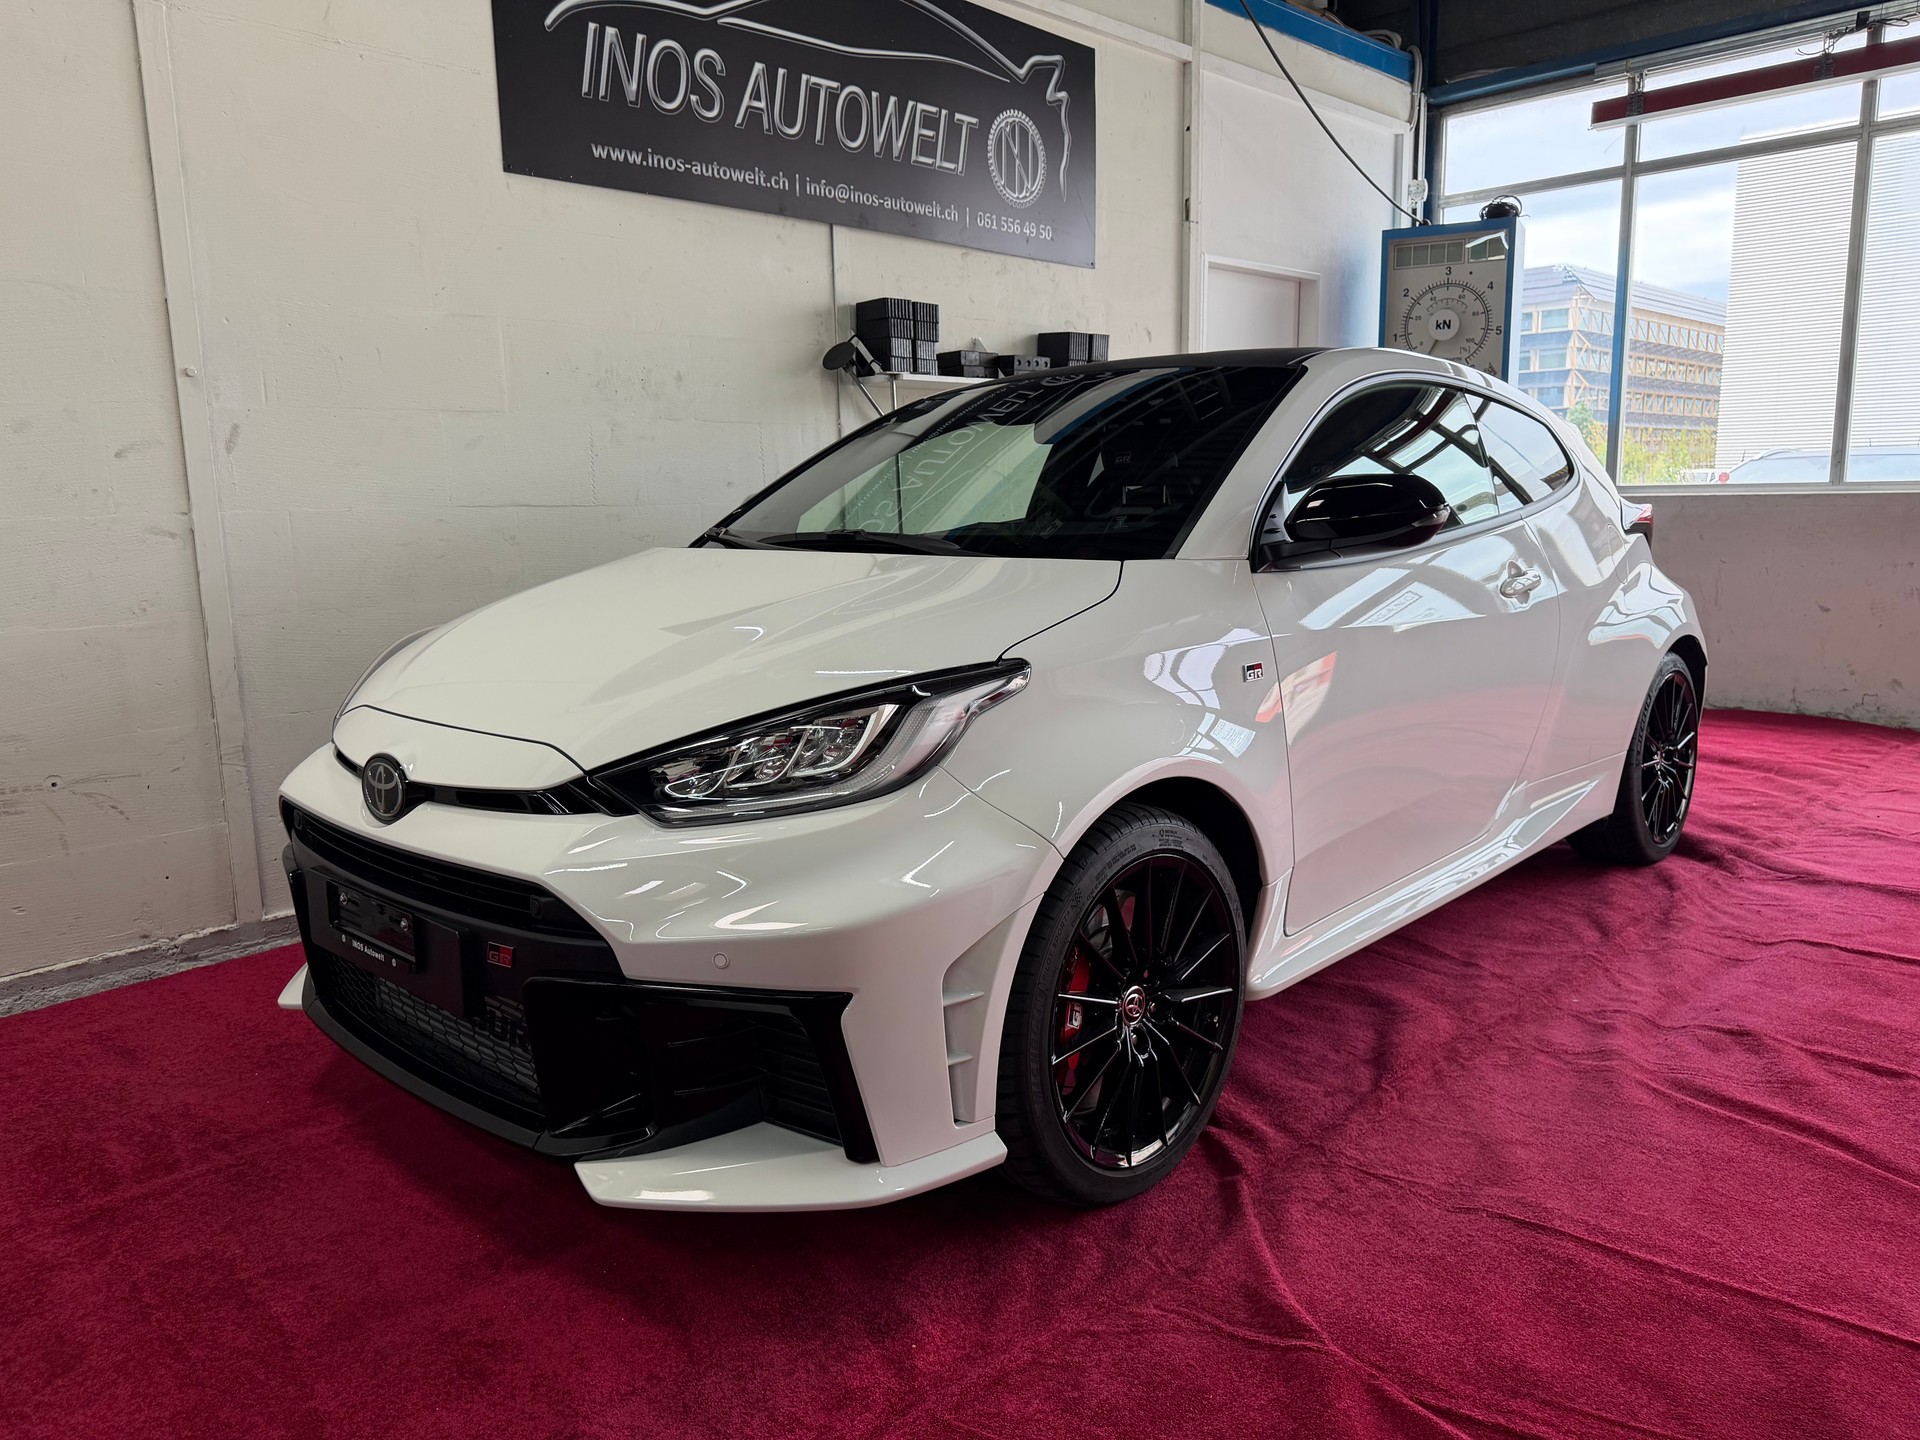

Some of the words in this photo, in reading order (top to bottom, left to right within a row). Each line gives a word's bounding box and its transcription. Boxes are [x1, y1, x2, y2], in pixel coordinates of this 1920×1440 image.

[582, 21, 726, 124] INOS
[735, 61, 979, 176] AUTOWELT
[591, 143, 789, 191] www.inos-autowelt.ch
[806, 177, 959, 222] info@inos-autowelt.ch
[977, 211, 998, 231] 061
[1000, 216, 1021, 235] 556
[1023, 221, 1037, 238] 49
[1039, 225, 1053, 241] 50
[1445, 266, 1452, 276] 3
[1487, 281, 1494, 290] 4
[1403, 288, 1410, 298] 2
[1435, 319, 1452, 330] kN
[1495, 326, 1503, 336] 5
[1393, 333, 1398, 342] 1
[1246, 669, 1264, 680] GR
[352, 939, 364, 952] INOS
[364, 945, 385, 962] Autowelt
[1041, 951, 1053, 982] PILOT
[1052, 915, 1070, 949] SPORT
[488, 951, 512, 965] GR
